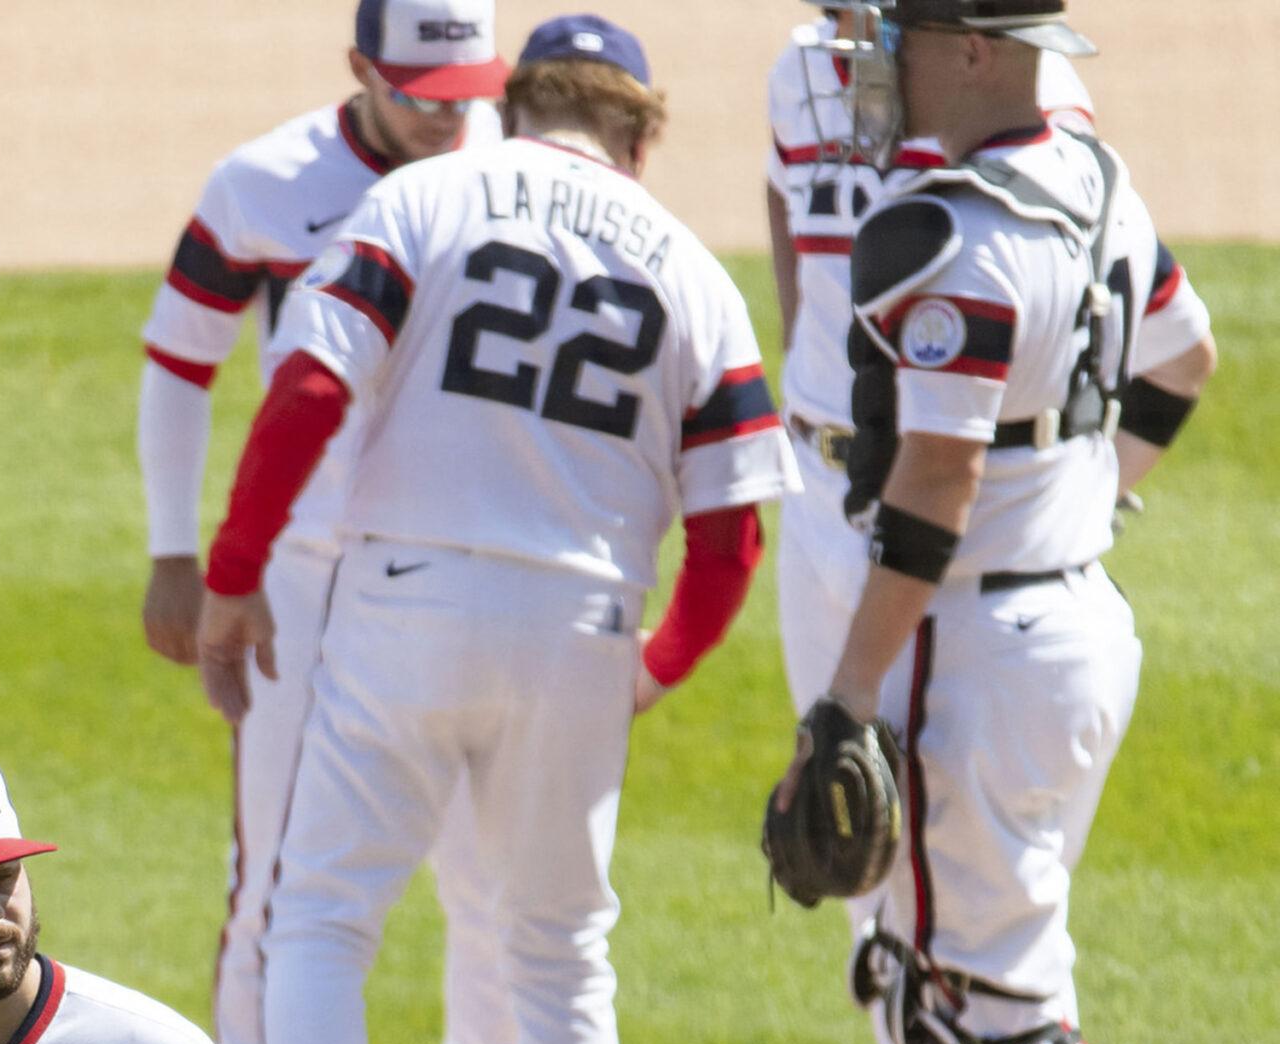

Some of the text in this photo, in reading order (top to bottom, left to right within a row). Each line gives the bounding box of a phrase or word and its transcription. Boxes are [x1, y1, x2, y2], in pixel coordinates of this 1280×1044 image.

[417, 19, 483, 42] SOX
[481, 171, 672, 274] LA RUSSA
[441, 240, 667, 441] 22
